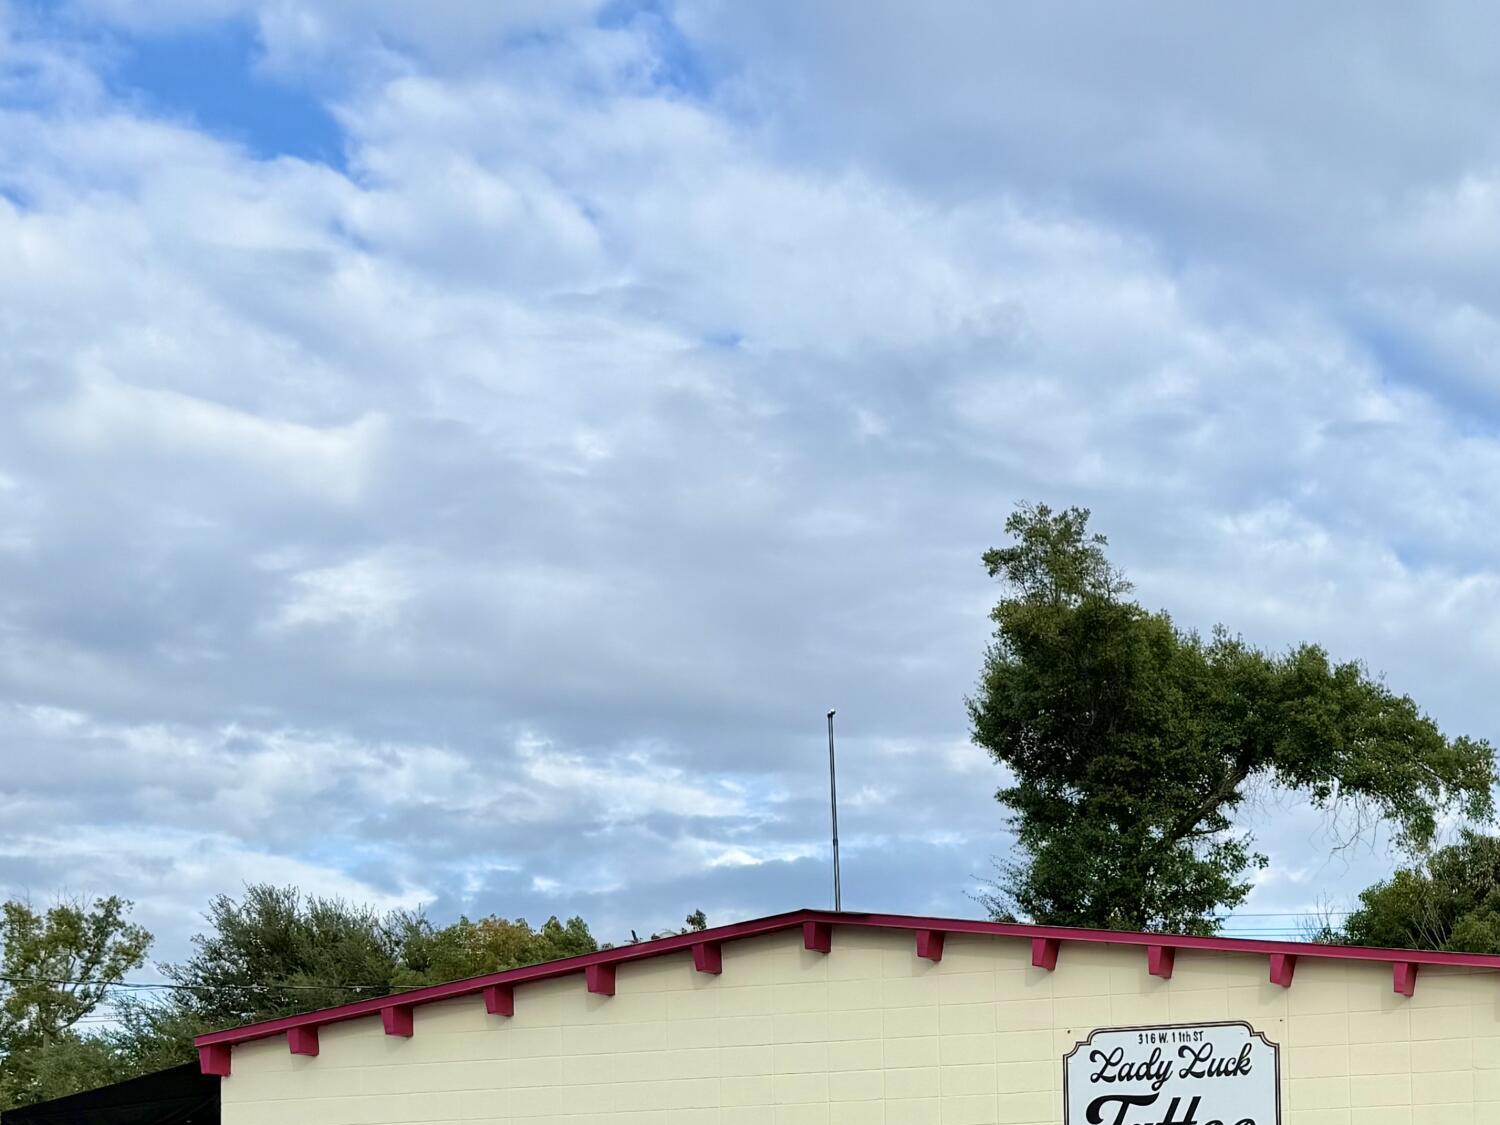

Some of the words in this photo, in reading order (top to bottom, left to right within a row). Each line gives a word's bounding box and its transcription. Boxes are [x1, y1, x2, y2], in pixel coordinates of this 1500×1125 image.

[1138, 1033, 1156, 1044] 316
[1159, 1032, 1168, 1043] W.
[1193, 1030, 1204, 1042] ST
[1089, 1047, 1173, 1091] Lady
[1178, 1042, 1252, 1079] Luck
